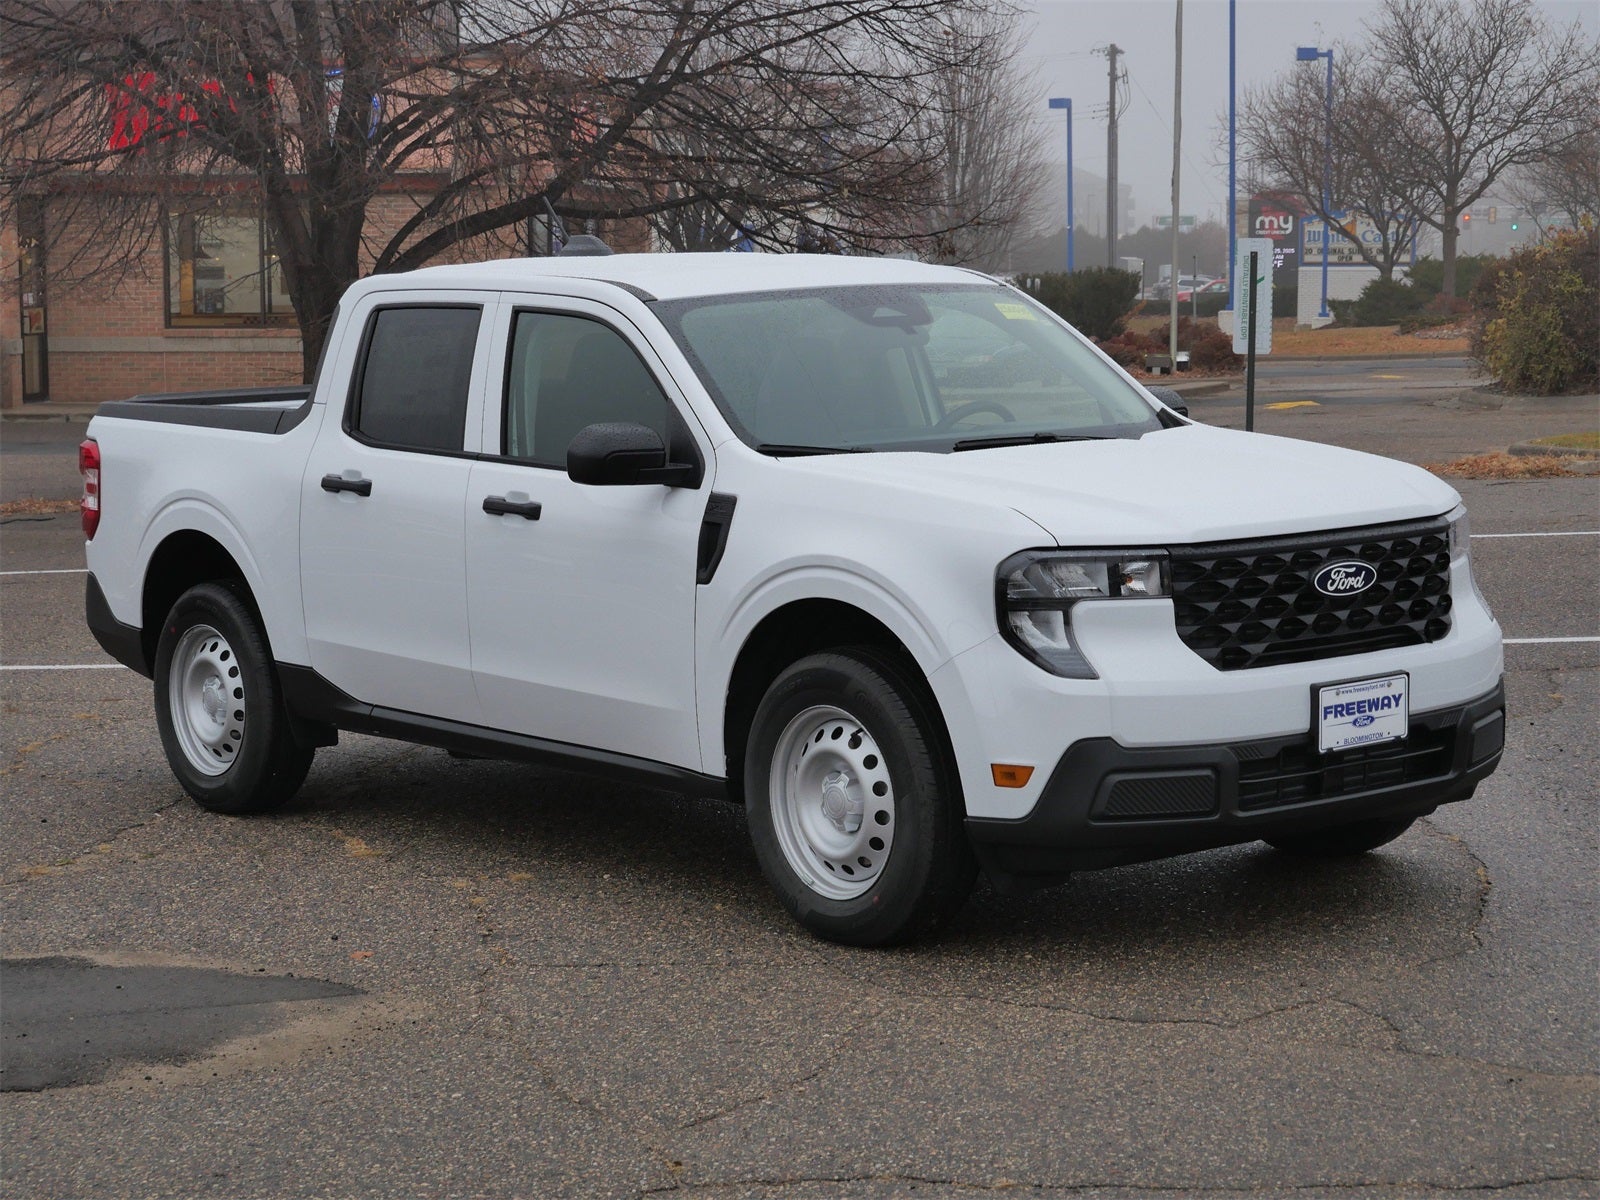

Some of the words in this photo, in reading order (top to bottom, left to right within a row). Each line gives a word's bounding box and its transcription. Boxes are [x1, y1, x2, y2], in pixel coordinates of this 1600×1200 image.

[1255, 215, 1293, 235] my
[1307, 230, 1349, 243] Wite
[1327, 566, 1366, 591] Ford
[1341, 682, 1386, 695] www.freewayford.net
[1323, 693, 1403, 720] FREEWAY
[1355, 715, 1372, 727] Ford
[1343, 732, 1384, 745] BLOOMINGTON
